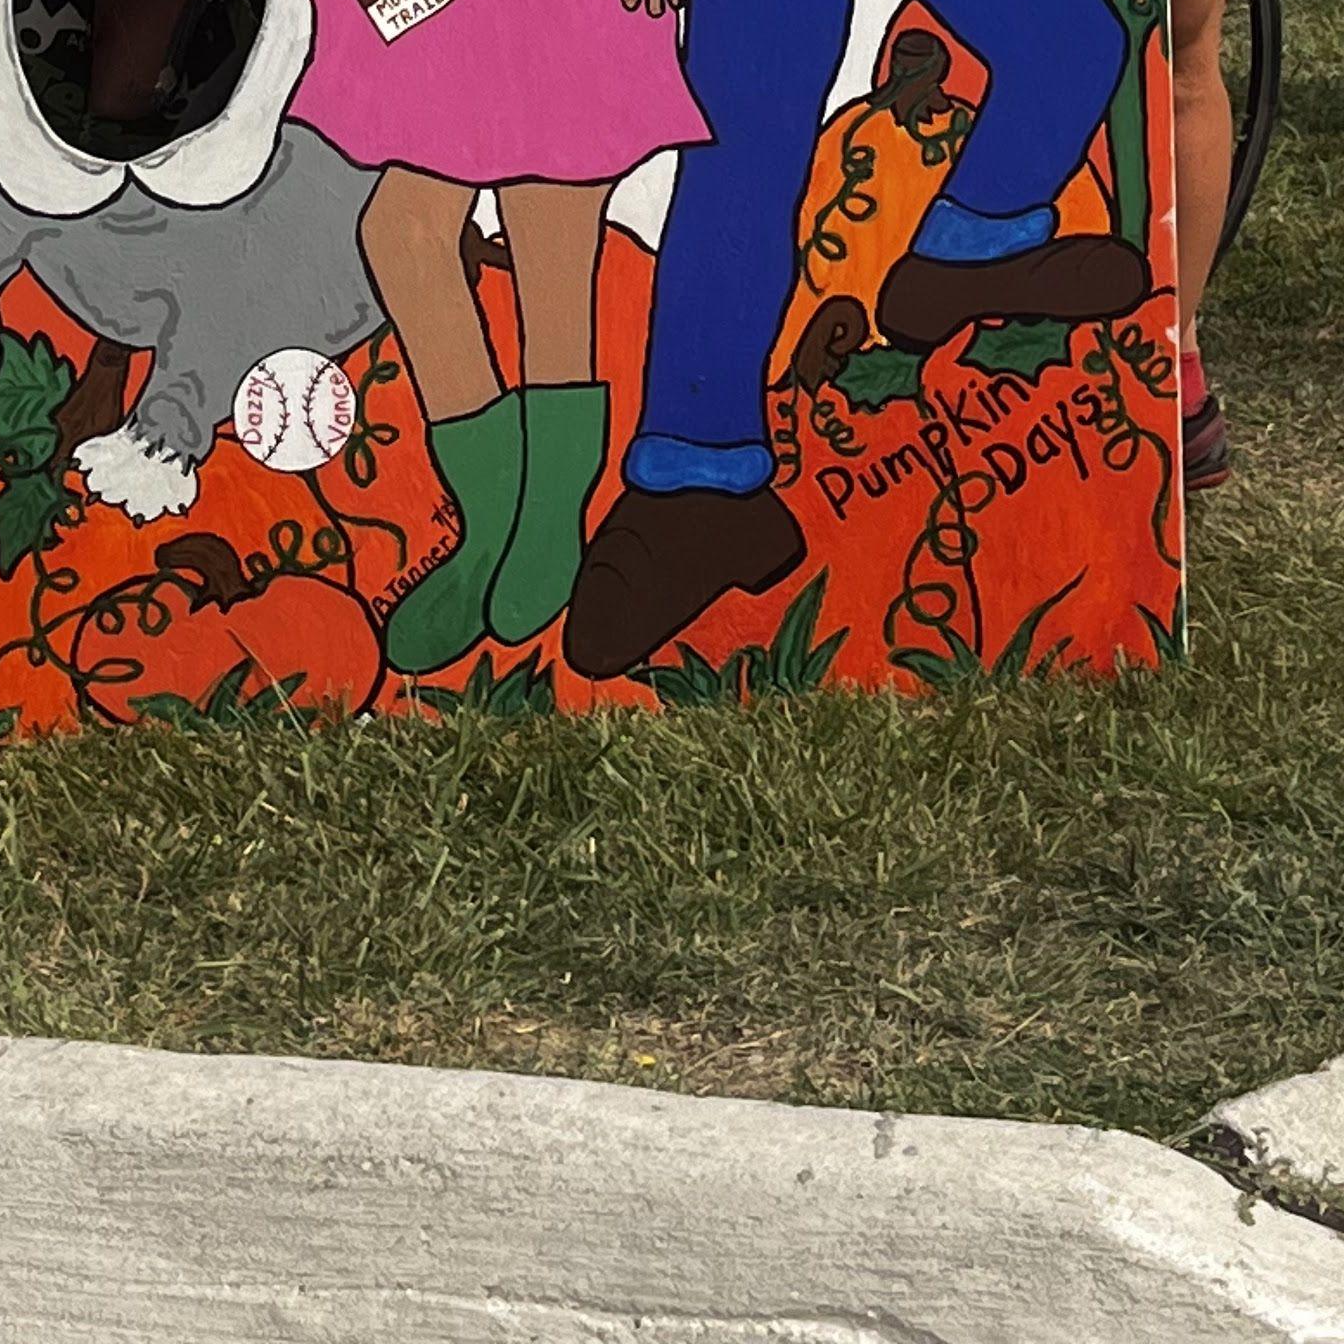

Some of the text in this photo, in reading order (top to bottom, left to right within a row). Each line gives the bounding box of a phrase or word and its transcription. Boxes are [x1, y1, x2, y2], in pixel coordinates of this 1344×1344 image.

[242, 376, 273, 445] Dazzy
[328, 372, 351, 444] Vance
[982, 384, 1100, 495] Days
